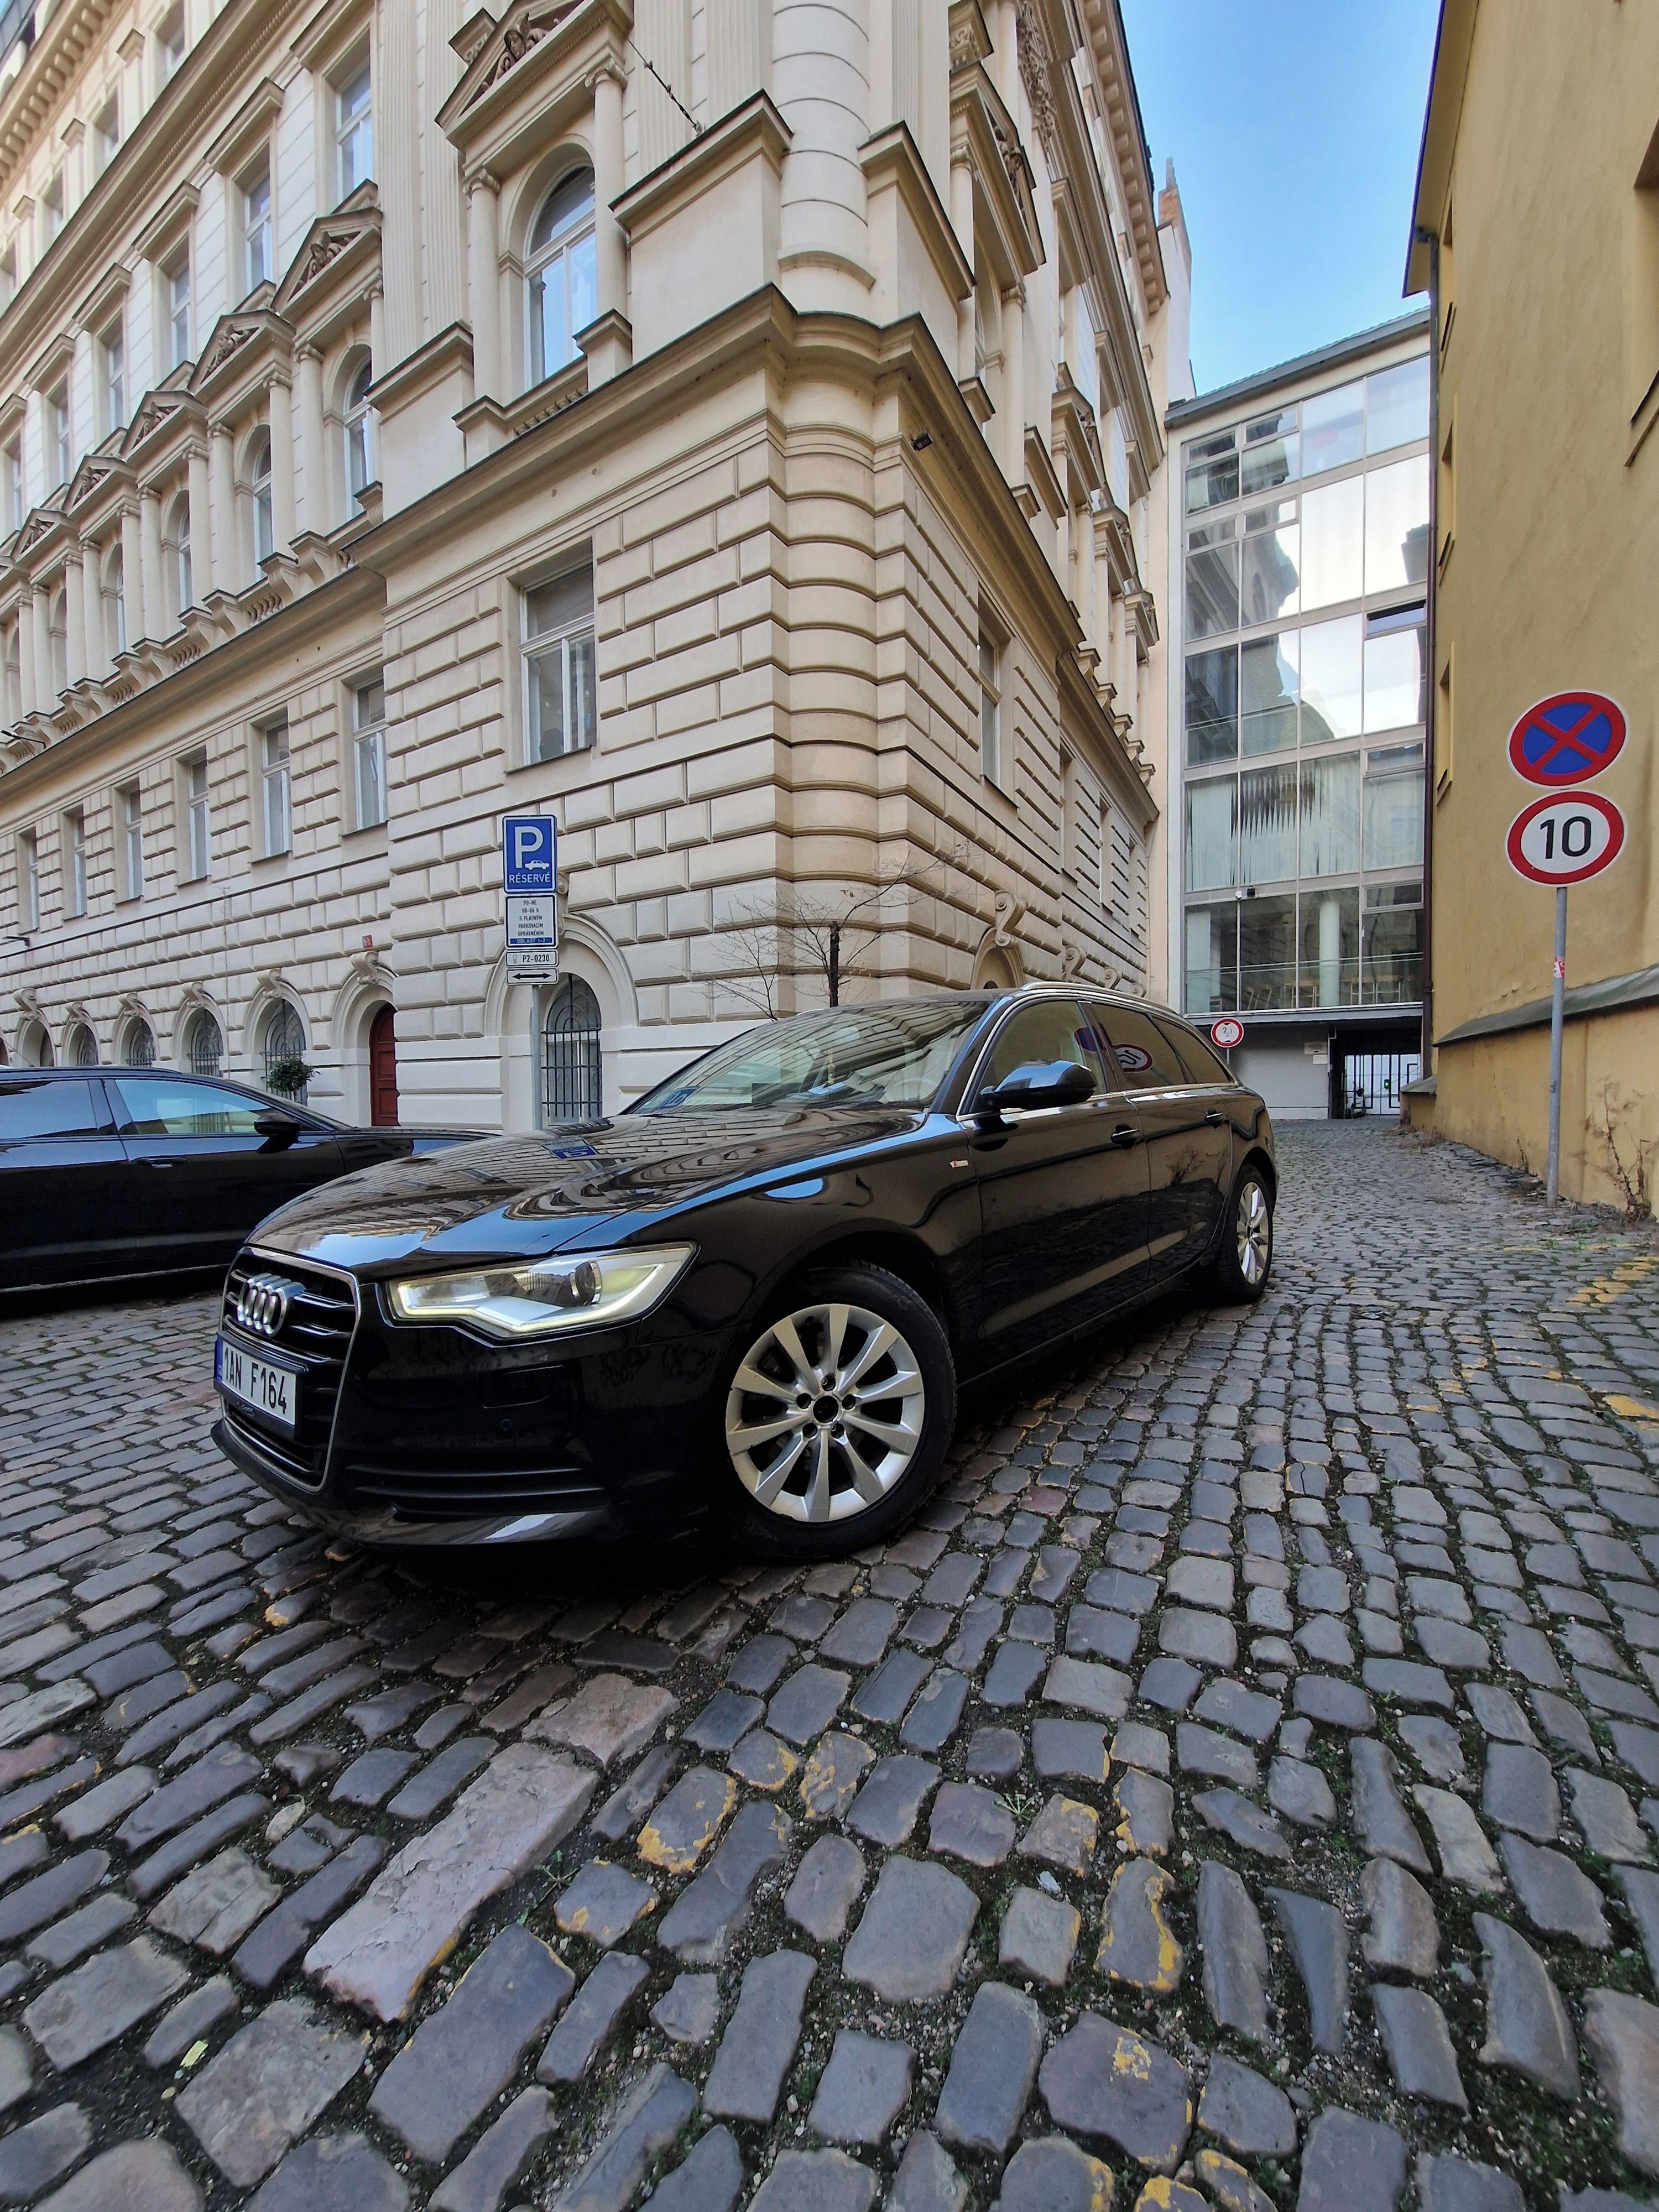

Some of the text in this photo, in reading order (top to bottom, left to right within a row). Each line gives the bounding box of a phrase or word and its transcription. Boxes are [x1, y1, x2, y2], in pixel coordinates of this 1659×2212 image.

[514, 826, 544, 869] P
[1540, 816, 1592, 859] 10
[509, 872, 551, 883] RÉSERVÉ
[522, 954, 550, 963] P2-0230
[225, 1347, 287, 1415] 1AN F164
